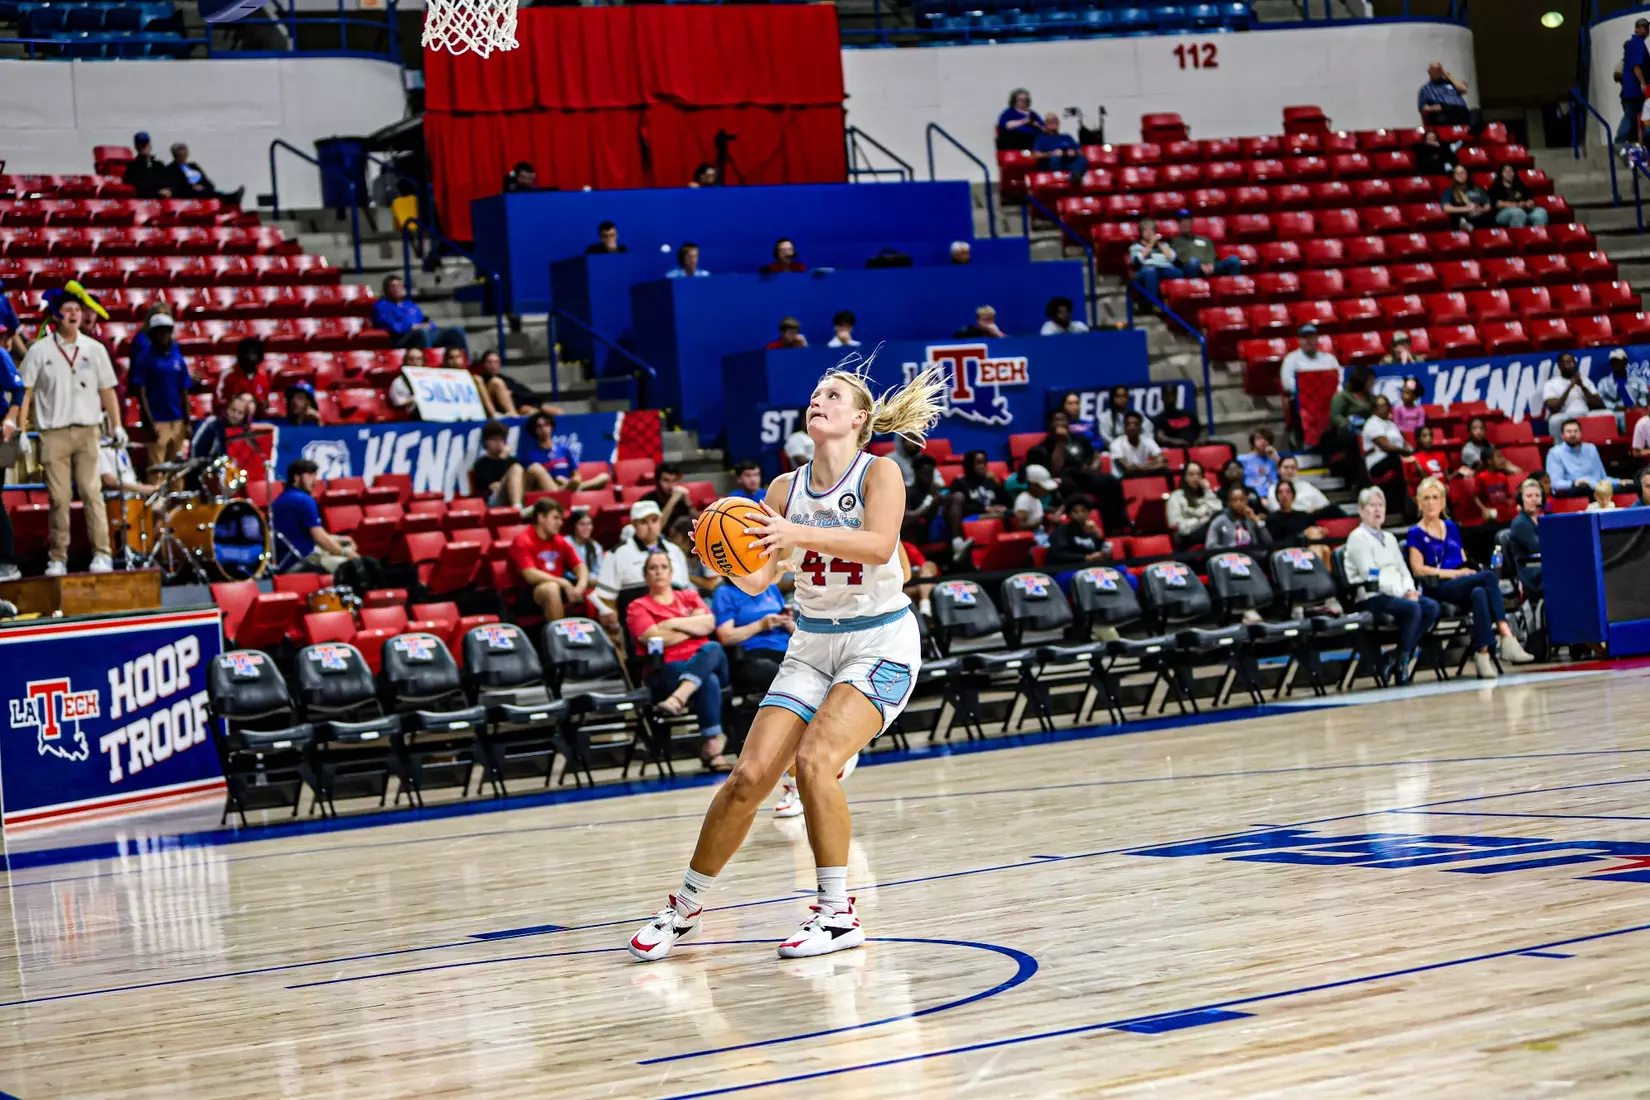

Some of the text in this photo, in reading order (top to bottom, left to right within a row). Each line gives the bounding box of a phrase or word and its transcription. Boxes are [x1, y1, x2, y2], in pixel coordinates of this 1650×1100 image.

[1173, 42, 1219, 70] 112
[801, 551, 863, 586] 44
[108, 634, 199, 719] HOOP
